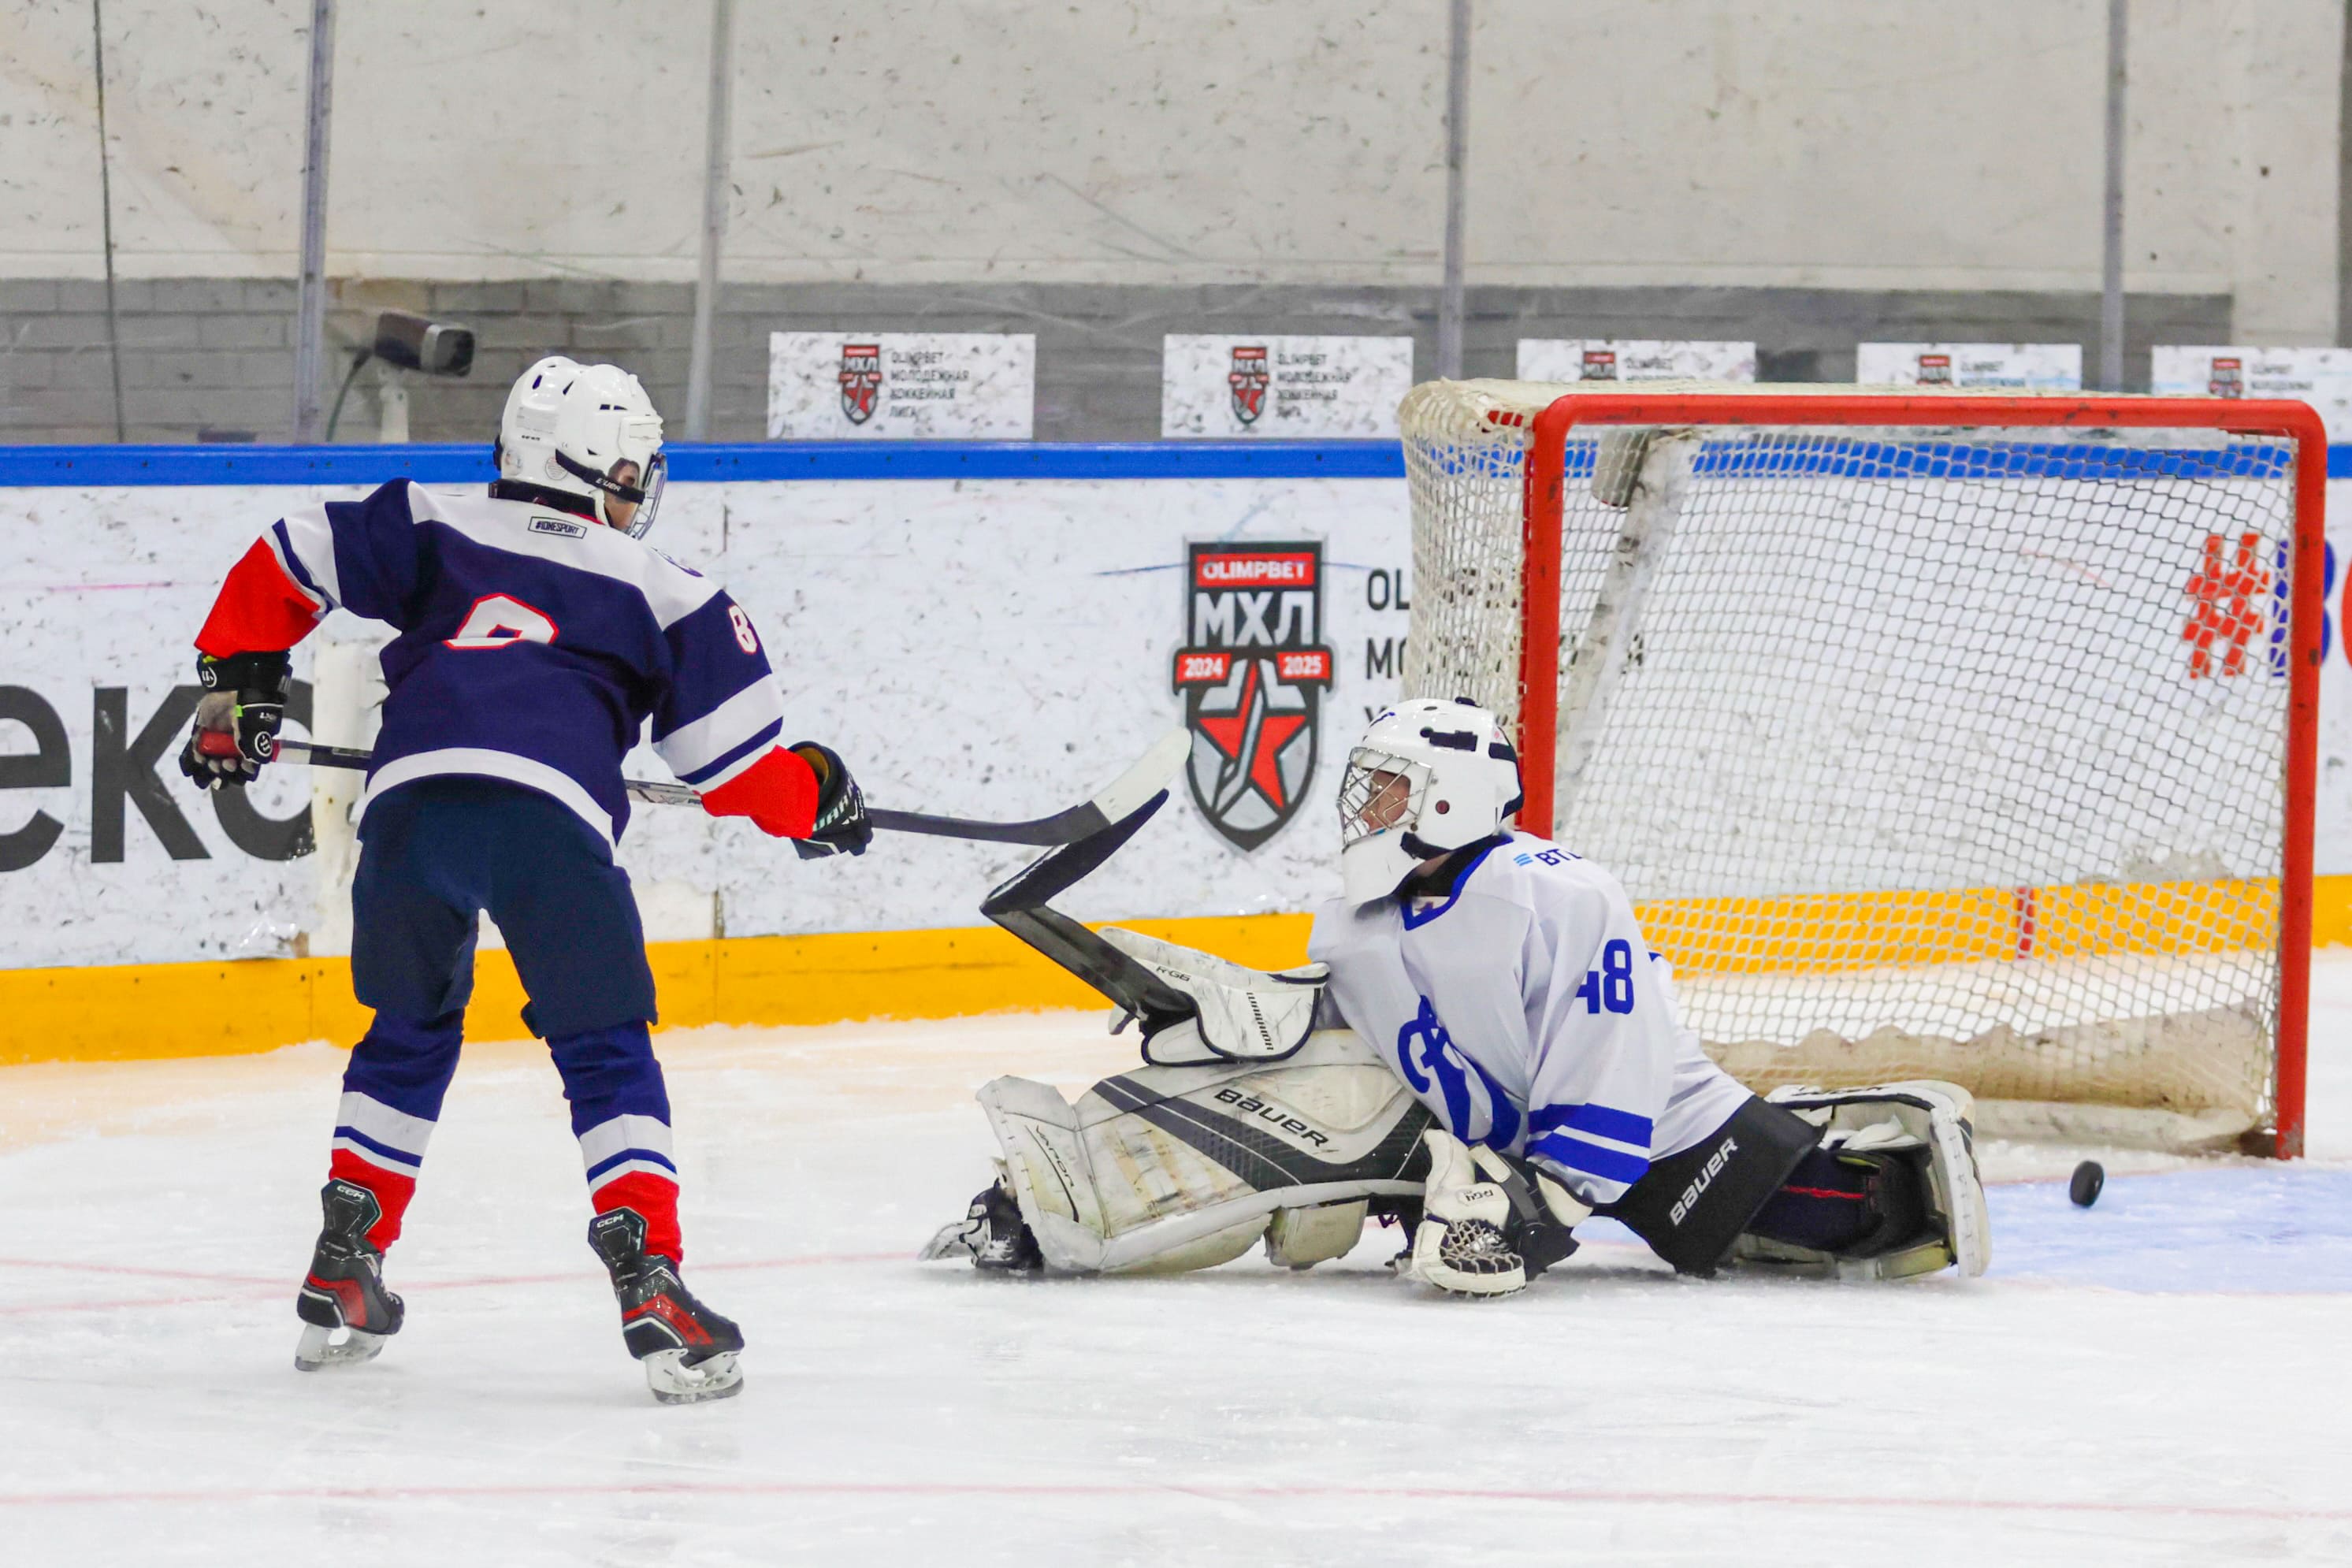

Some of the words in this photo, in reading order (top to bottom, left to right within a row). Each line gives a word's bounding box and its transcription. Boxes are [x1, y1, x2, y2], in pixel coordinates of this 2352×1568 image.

[1202, 561, 1306, 580] OLIMPBET
[1194, 590, 1315, 648] МХЛ
[728, 604, 759, 656] 8
[1184, 656, 1224, 678] 2024
[1283, 656, 1323, 676] 2025
[336, 1184, 366, 1200] CCM
[596, 1213, 625, 1229] CCM
